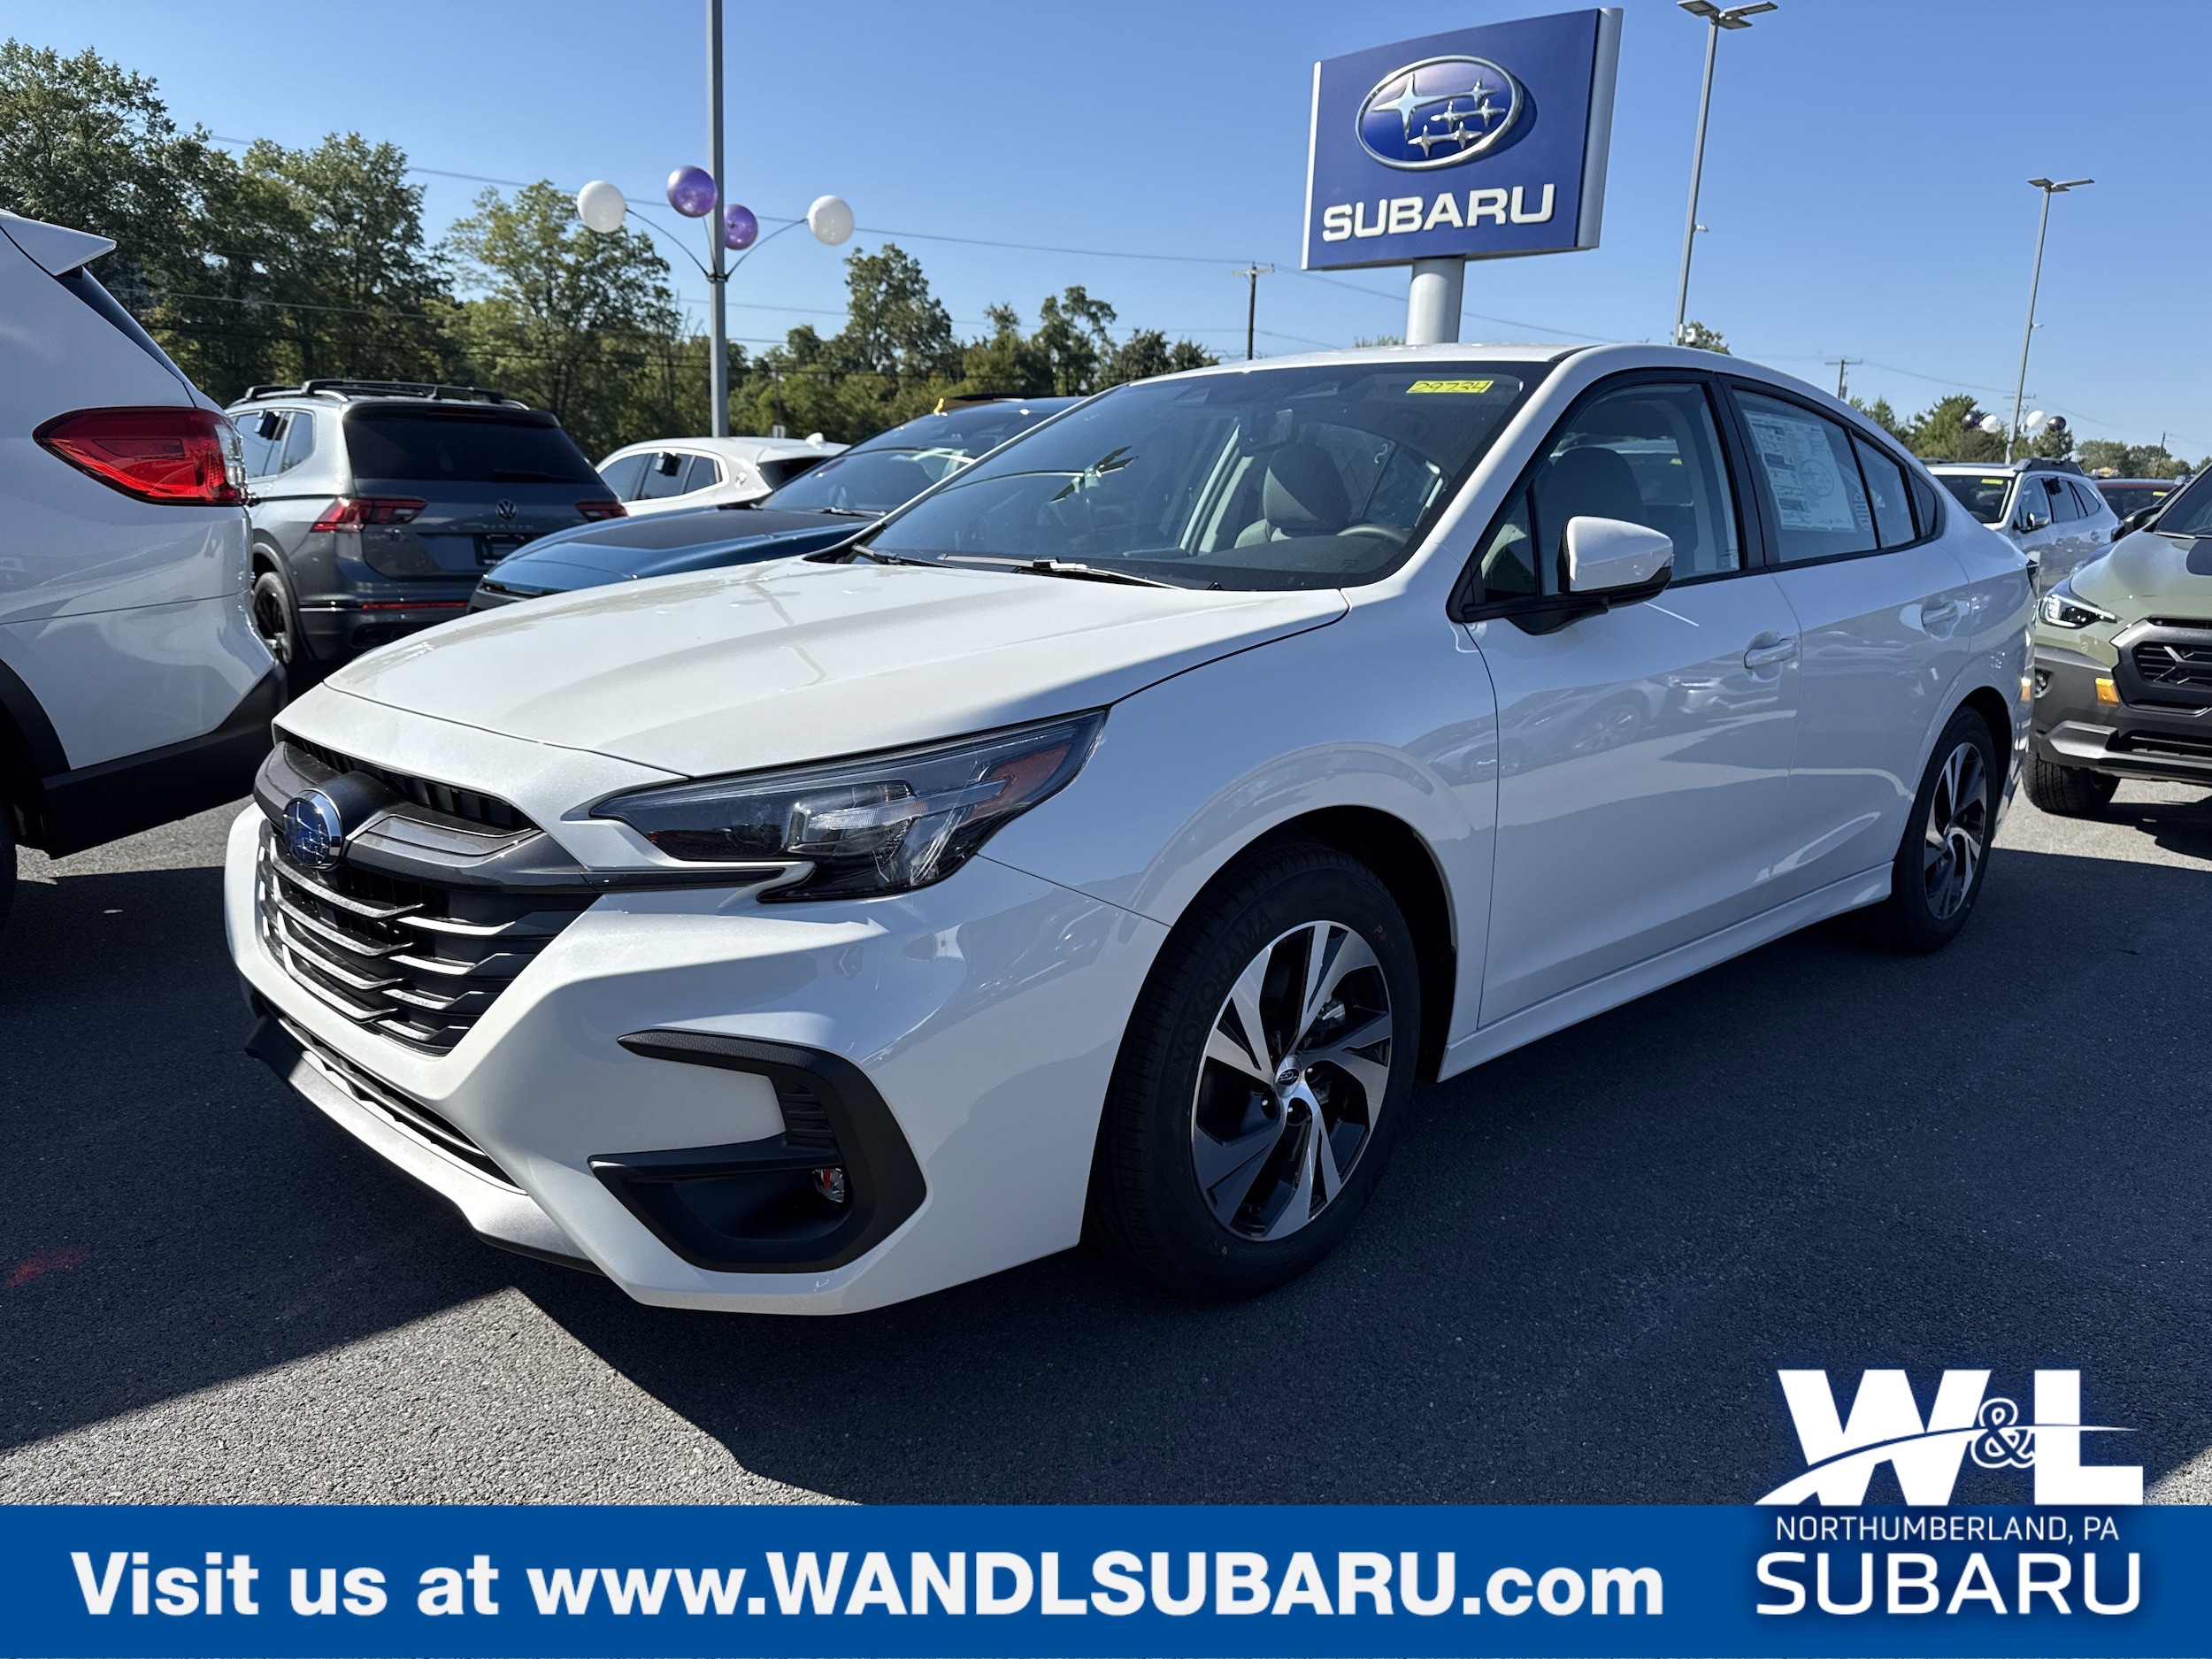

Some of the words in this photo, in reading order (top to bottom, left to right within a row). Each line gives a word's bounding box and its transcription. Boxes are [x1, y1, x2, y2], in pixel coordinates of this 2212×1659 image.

[1322, 183, 1555, 242] SUBARU
[1410, 381, 1490, 393] 29734
[1173, 907, 1273, 1064] YOKOHAMA
